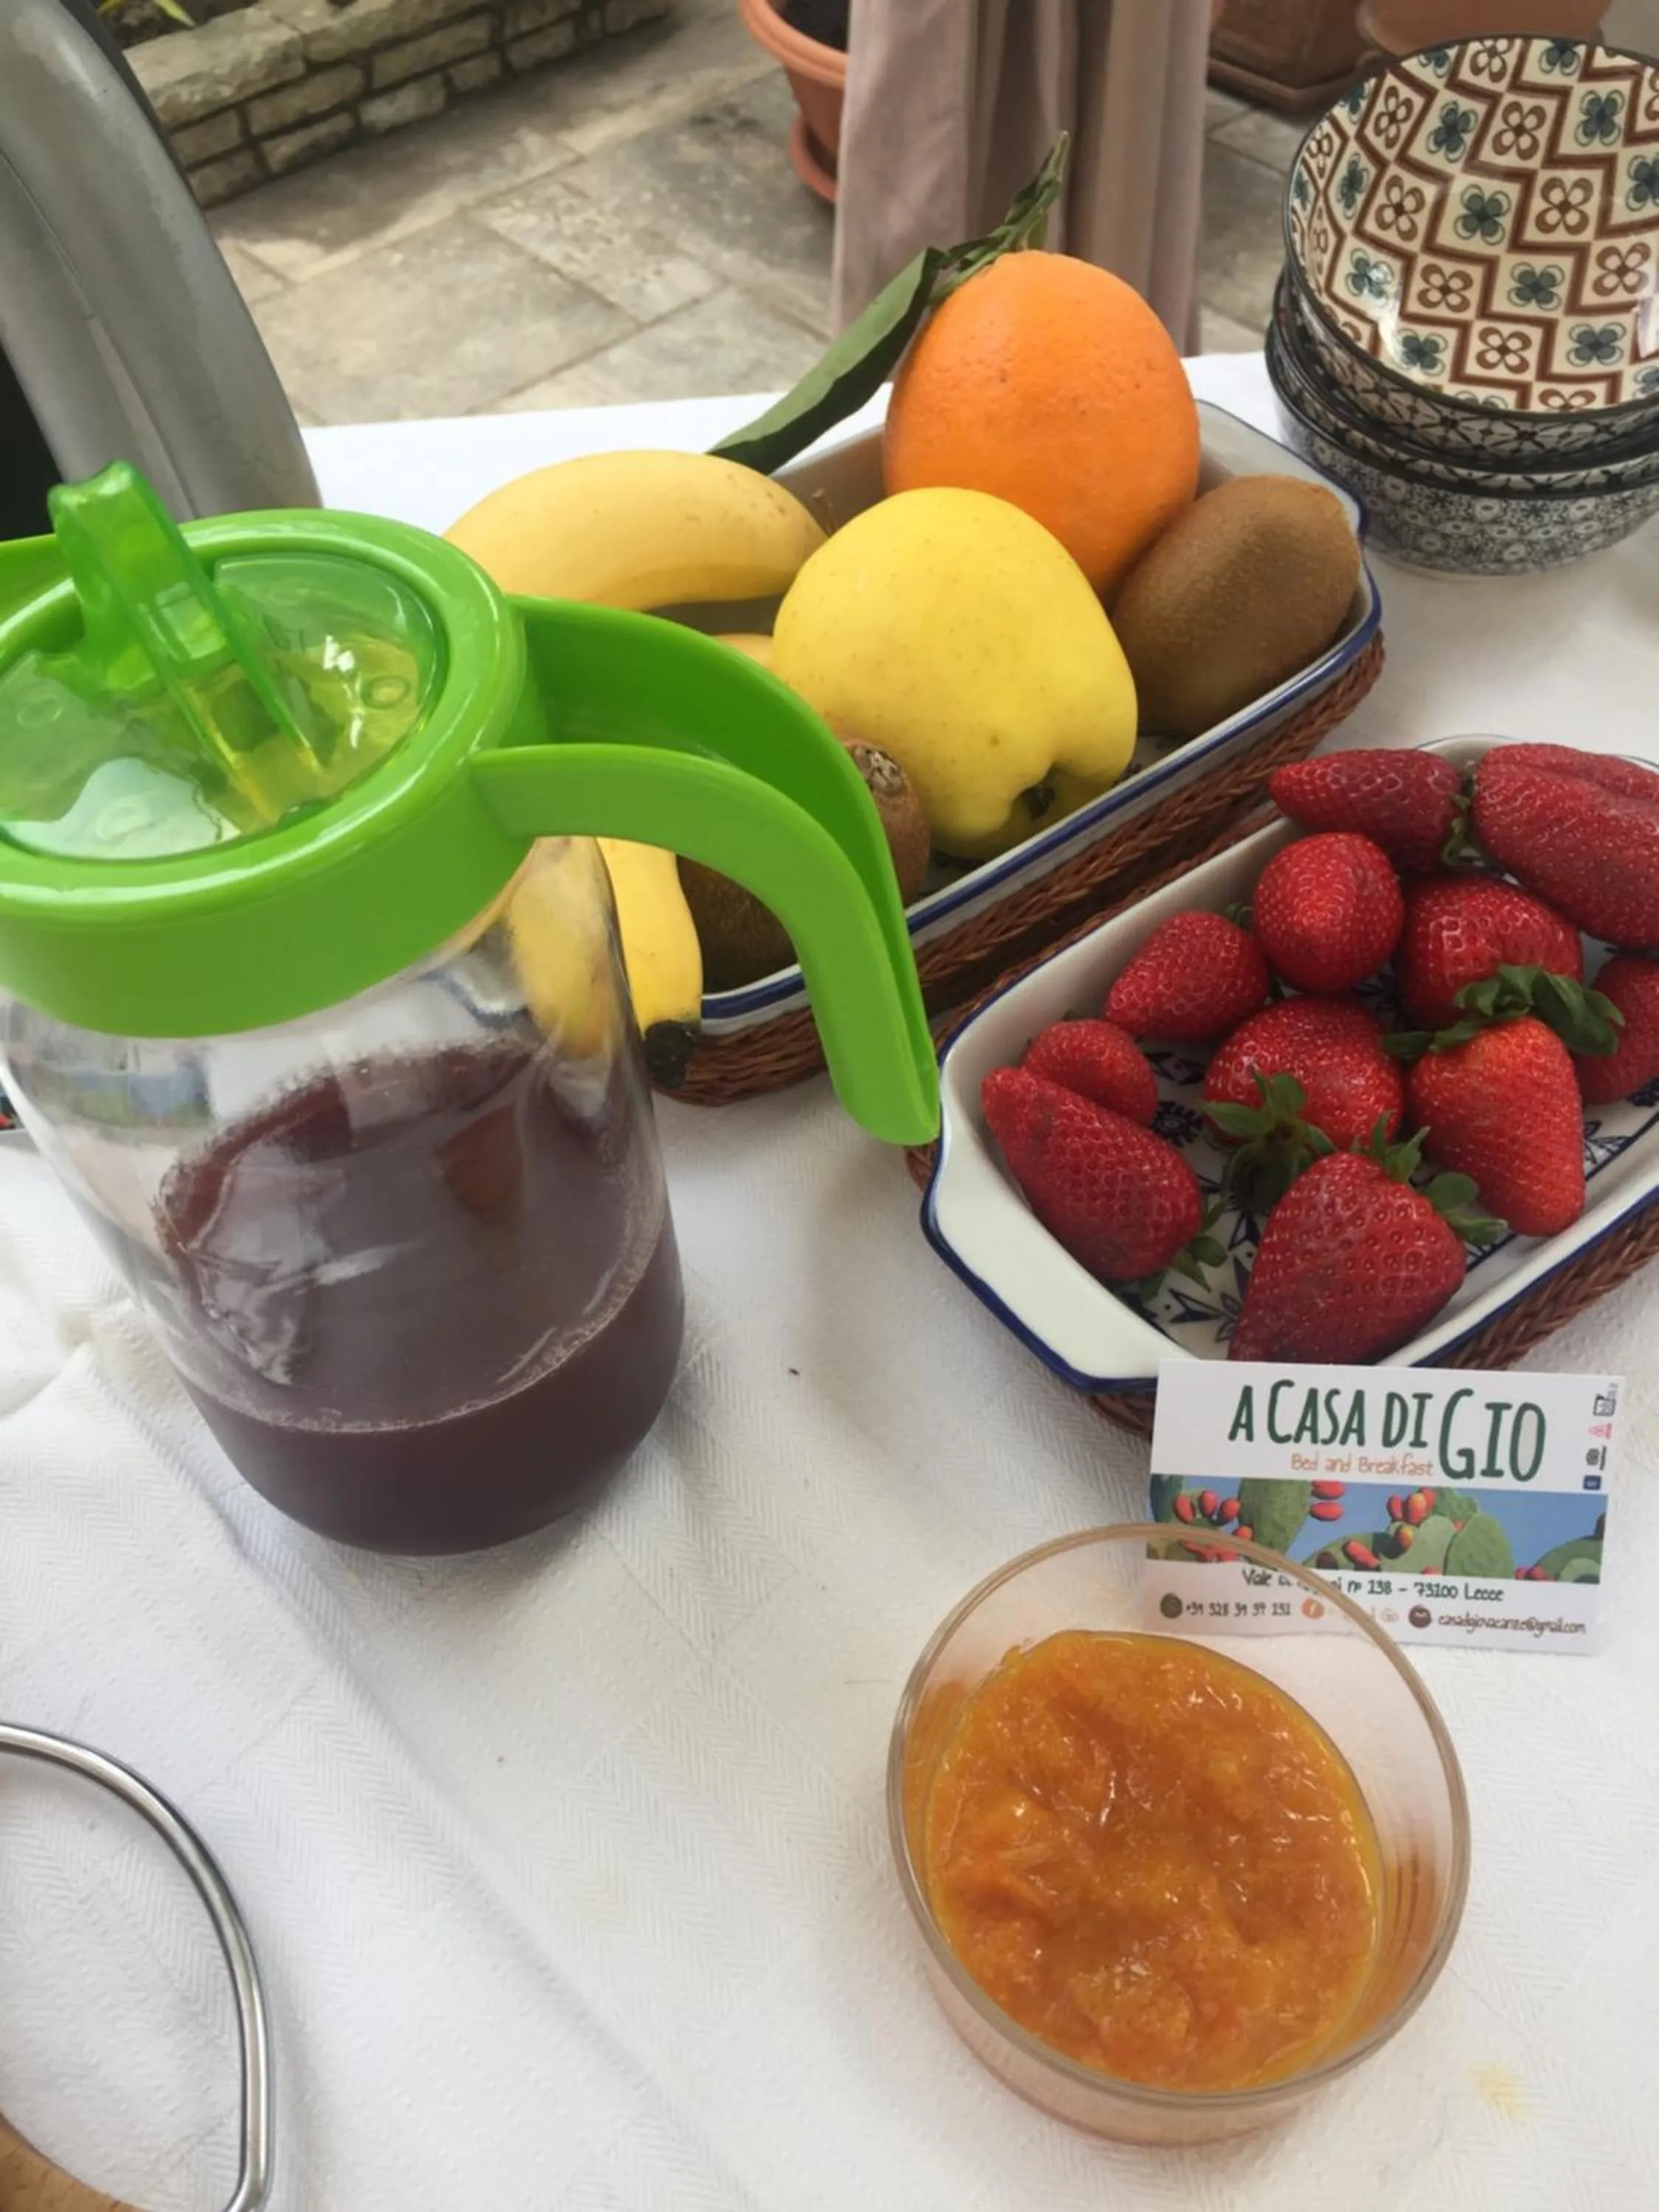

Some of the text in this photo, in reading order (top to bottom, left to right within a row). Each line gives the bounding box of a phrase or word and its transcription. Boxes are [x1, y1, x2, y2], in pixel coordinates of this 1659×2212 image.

[1228, 1385, 1253, 1442] A
[1267, 1380, 1366, 1447] CASA
[1439, 1388, 1546, 1482] GIO
[1291, 1451, 1434, 1476] Bed and Breakfast
[1367, 1579, 1393, 1596] 138
[1413, 1581, 1458, 1599] 73100
[1464, 1582, 1504, 1602] Lecce
